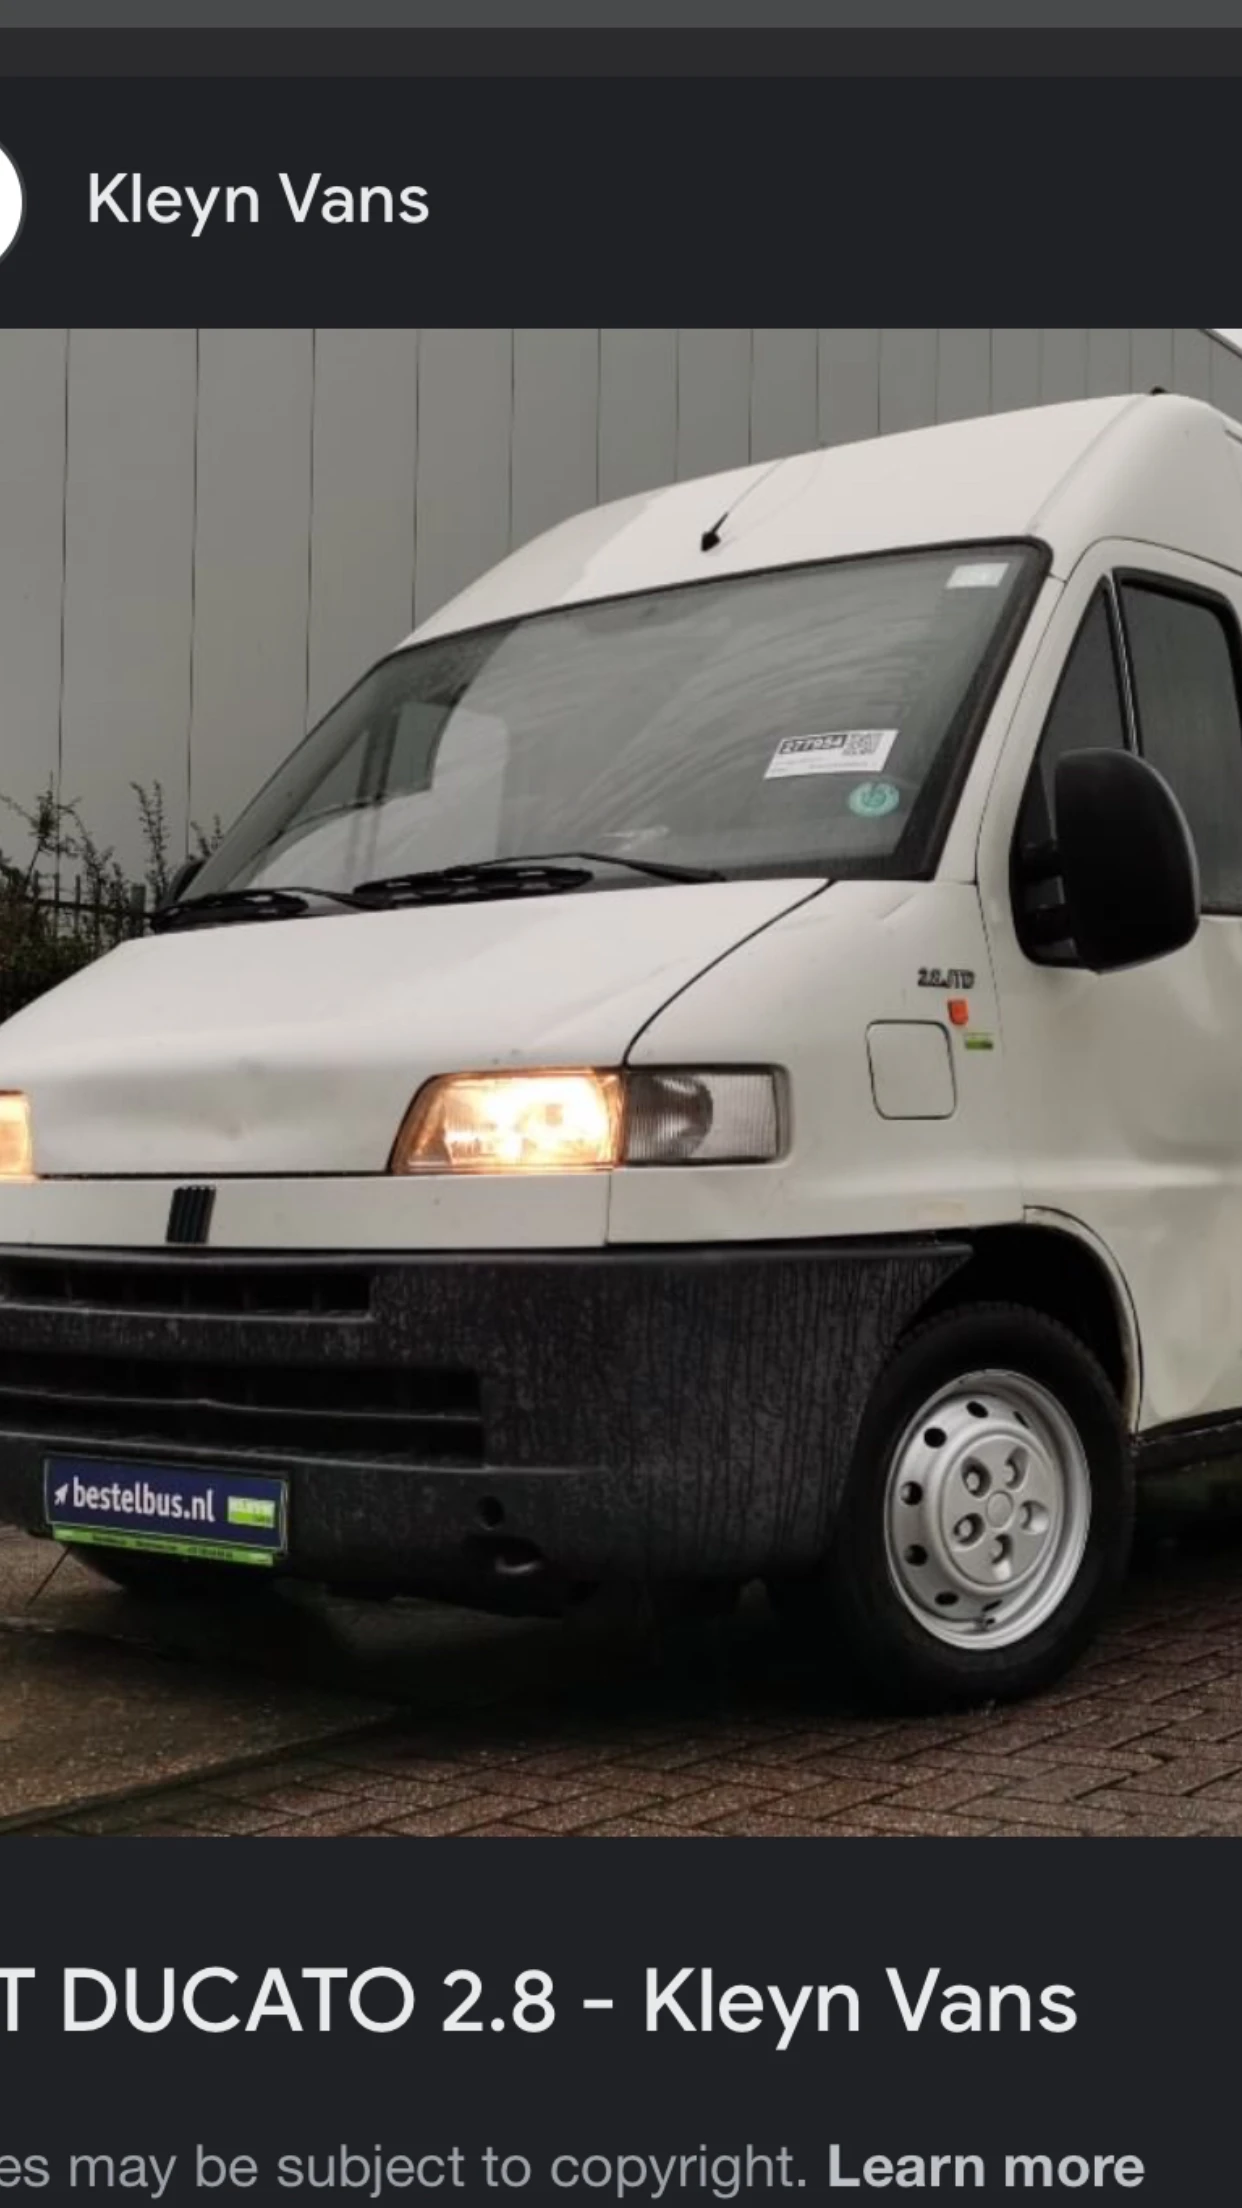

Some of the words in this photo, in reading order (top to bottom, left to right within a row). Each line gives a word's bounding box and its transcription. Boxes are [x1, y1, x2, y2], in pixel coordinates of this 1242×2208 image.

[89, 173, 259, 237] Kleyn
[278, 173, 430, 225] Vans
[73, 1475, 215, 1523] bestelbus.nl
[64, 1966, 415, 2034] DUCATO
[443, 1969, 555, 2034] 2.8
[583, 1998, 613, 2009] -
[646, 1967, 859, 2051] Kleyn
[885, 1967, 1077, 2034] Vans
[70, 2154, 177, 2199] may
[196, 2144, 258, 2188] be
[277, 2144, 465, 2199] subject
[481, 2146, 532, 2188] to
[551, 2144, 806, 2199] copyright.
[829, 2144, 985, 2188] Learn
[1005, 2154, 1145, 2188] more
